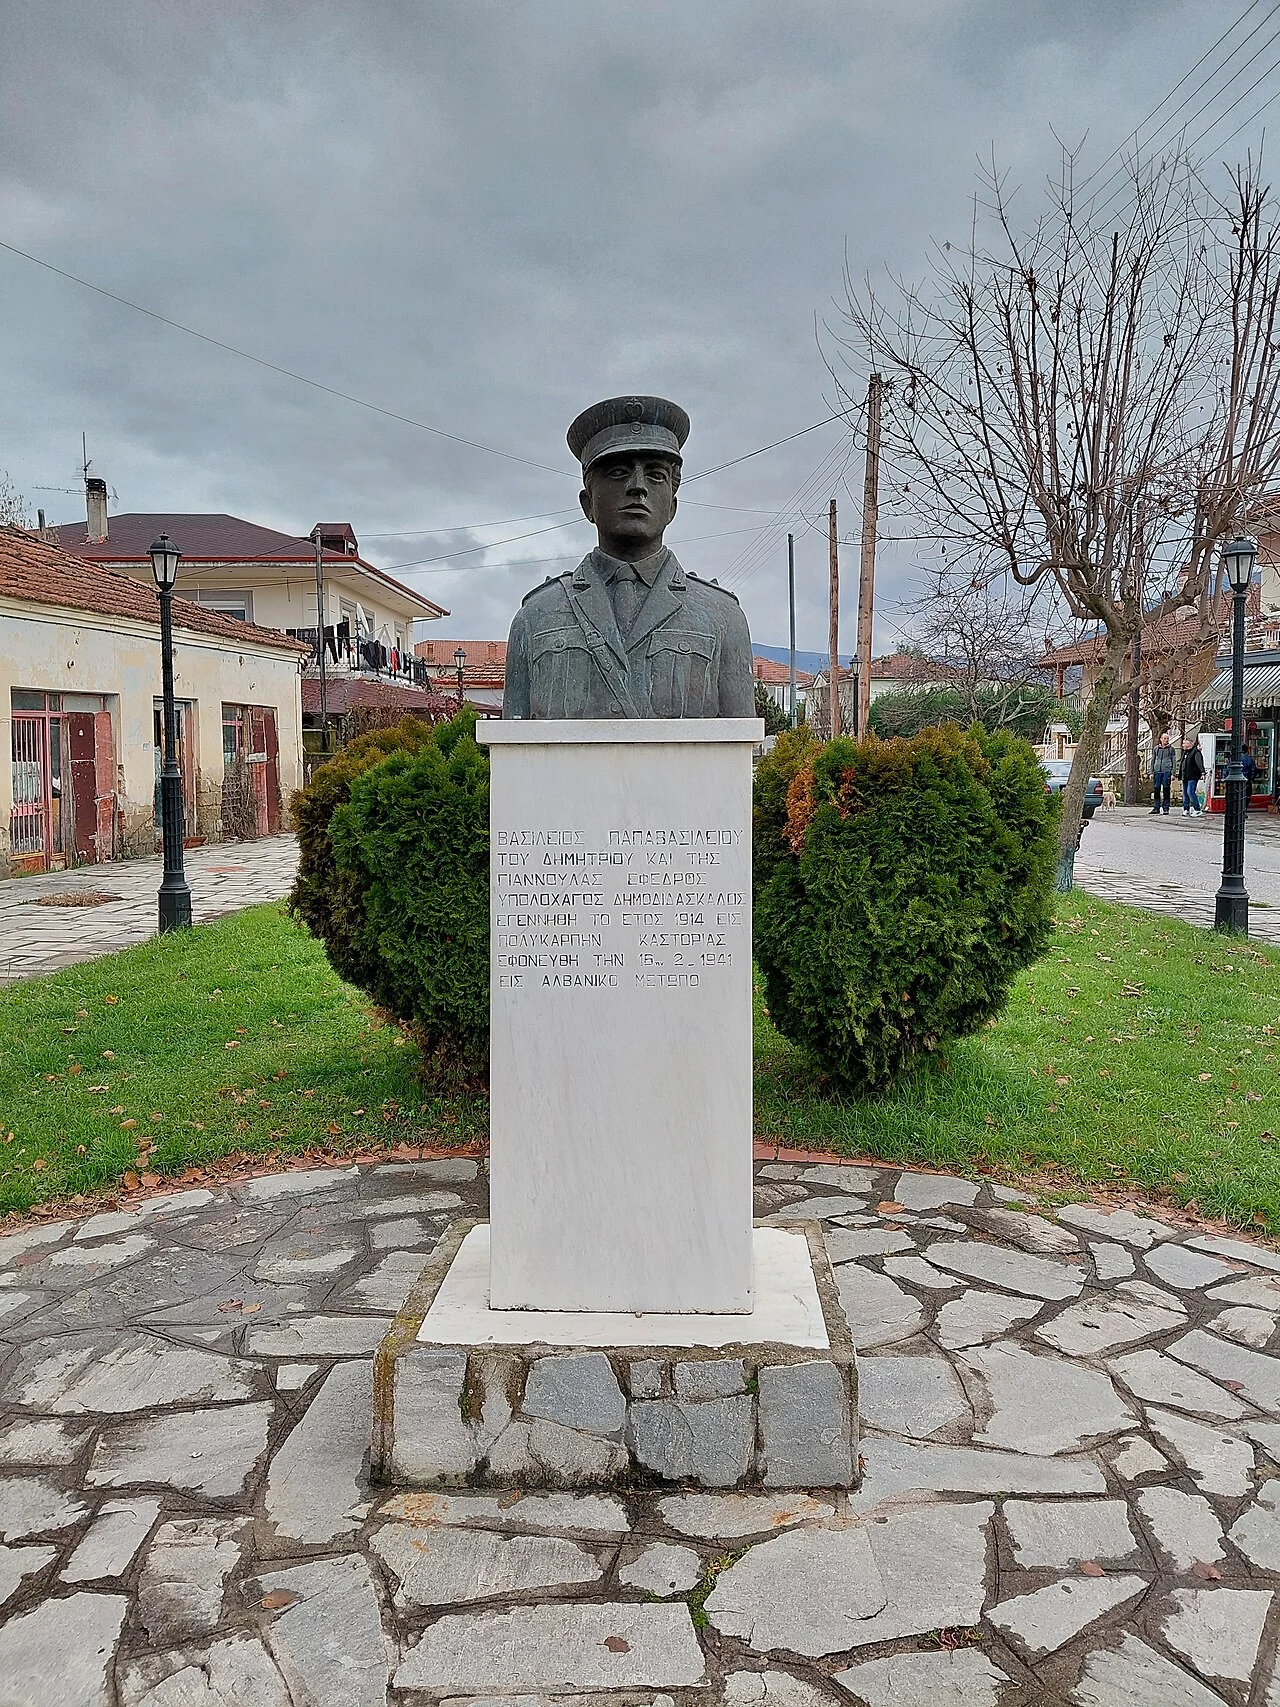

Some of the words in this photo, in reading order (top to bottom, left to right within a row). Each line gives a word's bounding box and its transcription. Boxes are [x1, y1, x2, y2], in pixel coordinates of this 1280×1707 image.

[497, 830, 585, 846] ΒΑΣΙΛΕΙΟΣ
[608, 830, 744, 846] ΠΑΠΑΒΑΣΙΛΕΙΟΥ
[496, 852, 530, 866] ΤΟΥ
[542, 852, 634, 866] ΔΗΜΗΤΡΙΟΥ
[646, 852, 673, 866] ΚΑΙ
[686, 852, 721, 866] ΤΗΣ
[497, 872, 603, 887] ΓΙΑΝΝΟΥΛΑΣ
[627, 872, 707, 887] ΕΦΕΔΡΟΣ
[498, 892, 604, 907] ΥΠΟΛΟΧΑΓΟΣ
[613, 892, 747, 907] ΔΗΜΟΔΙΔΑΣΚΑΛΟΣ
[496, 913, 577, 927] ΕΓΕΝΝΗΘΗ
[589, 913, 610, 927] ΤΟ
[622, 912, 664, 927] ΕΤΟΣ
[674, 912, 705, 926] 1914
[716, 912, 742, 926] ΕΙΣ
[498, 933, 602, 948] ΠΟΛΥΚΑΡΠΗΝ
[639, 932, 727, 947] ΚΑΣΤΟΡΙΑΣ
[497, 954, 579, 968] ΕΦΟΝΕΥΘΗ
[592, 953, 624, 967] ΤΗΝ
[499, 974, 524, 988] ΕΙΣ
[541, 973, 618, 988] ΑΛΒΑΝΙΚΟ
[635, 973, 700, 987] ΜΕΤΩΠΟ
